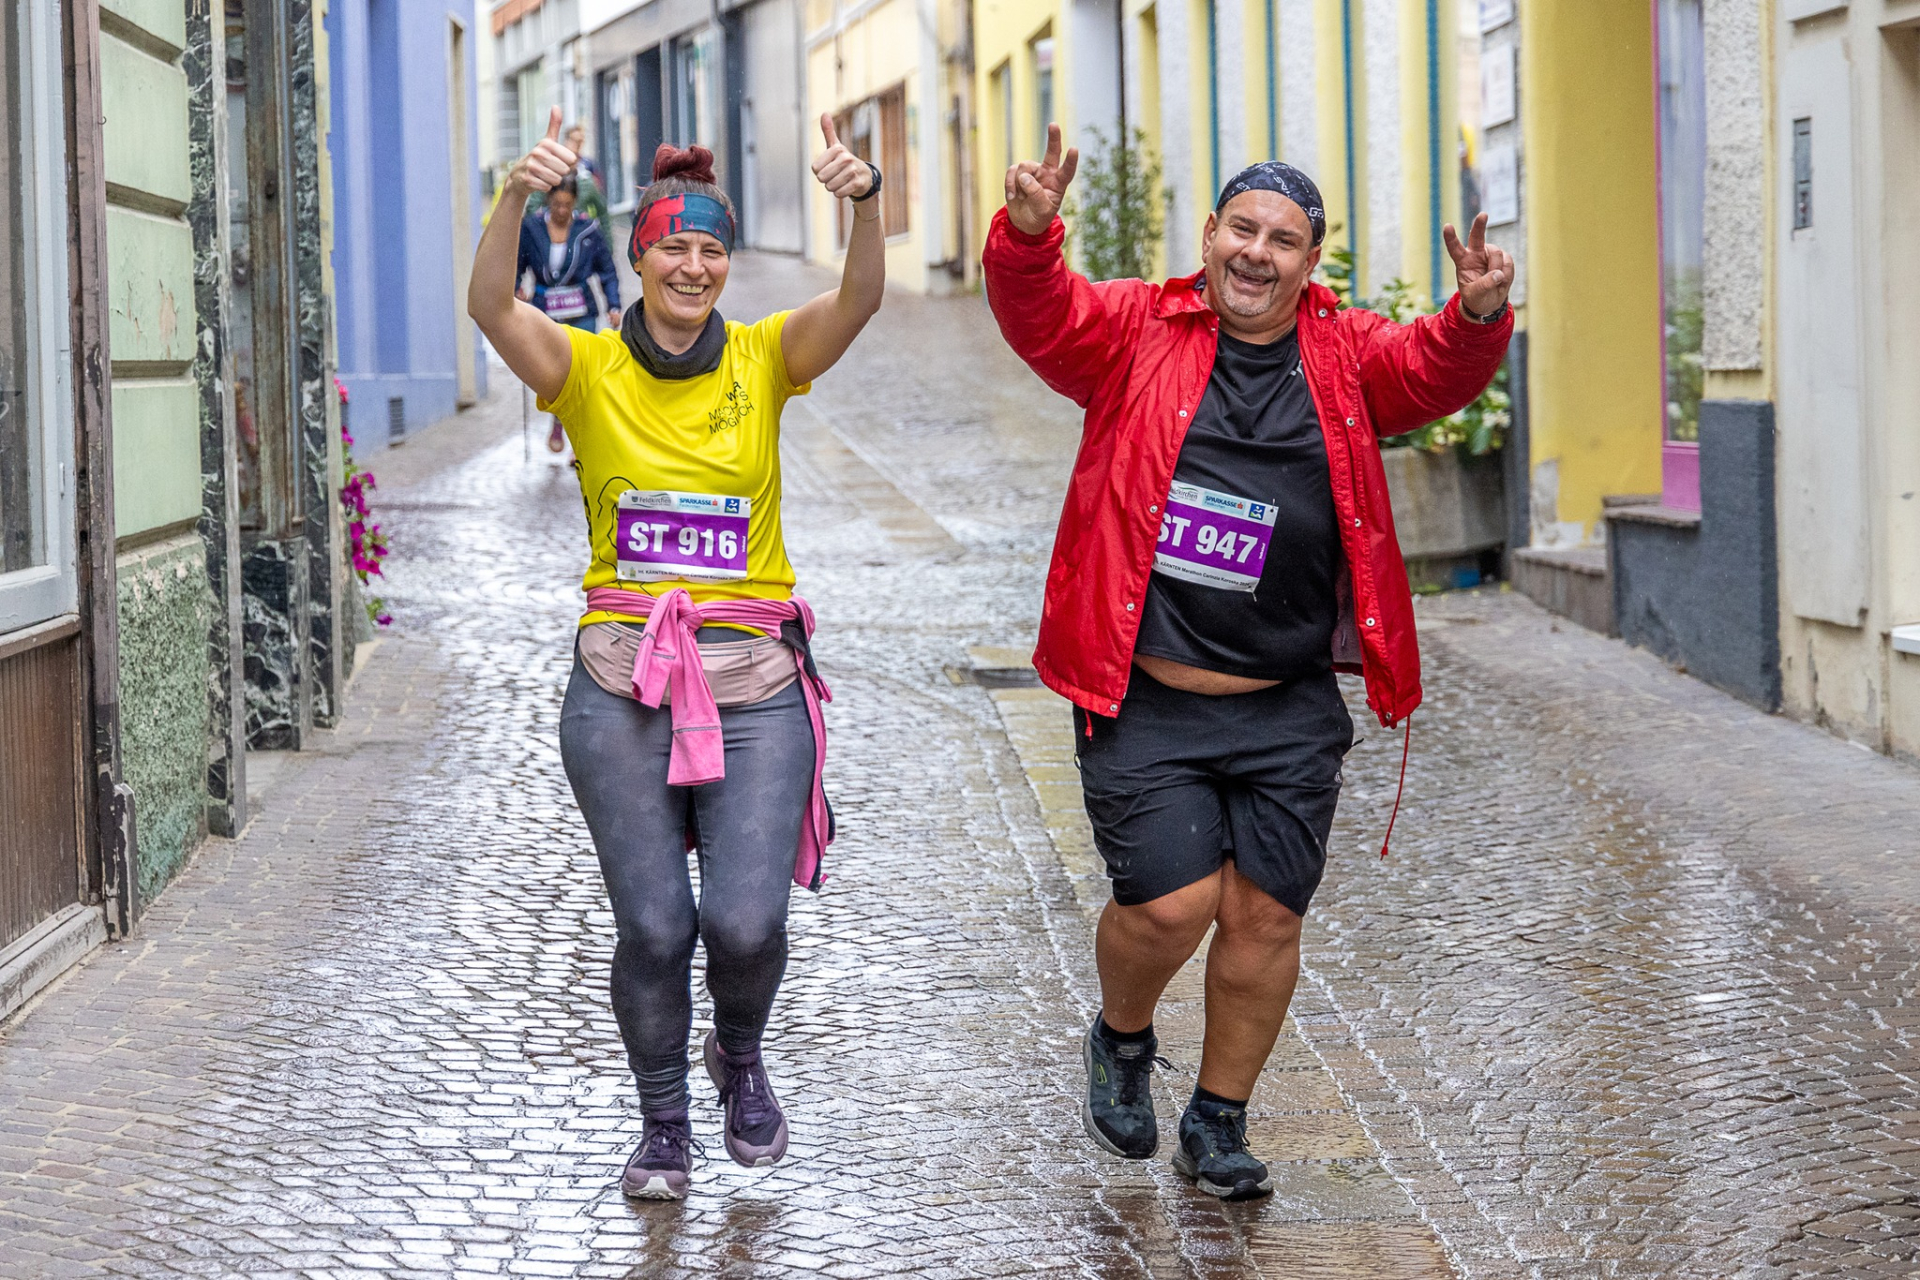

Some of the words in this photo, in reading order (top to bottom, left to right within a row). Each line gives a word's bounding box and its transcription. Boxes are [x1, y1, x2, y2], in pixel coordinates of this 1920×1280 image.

[639, 496, 672, 504] Feldkirchen
[679, 497, 712, 506] SPARKASSE
[1205, 495, 1237, 508] SPARKASSE
[628, 521, 670, 553] ST
[678, 527, 738, 560] 916
[1157, 512, 1192, 547] ST
[1195, 525, 1259, 564] 947
[1160, 561, 1181, 571] KÄRNTEN
[1182, 567, 1202, 577] Marathon
